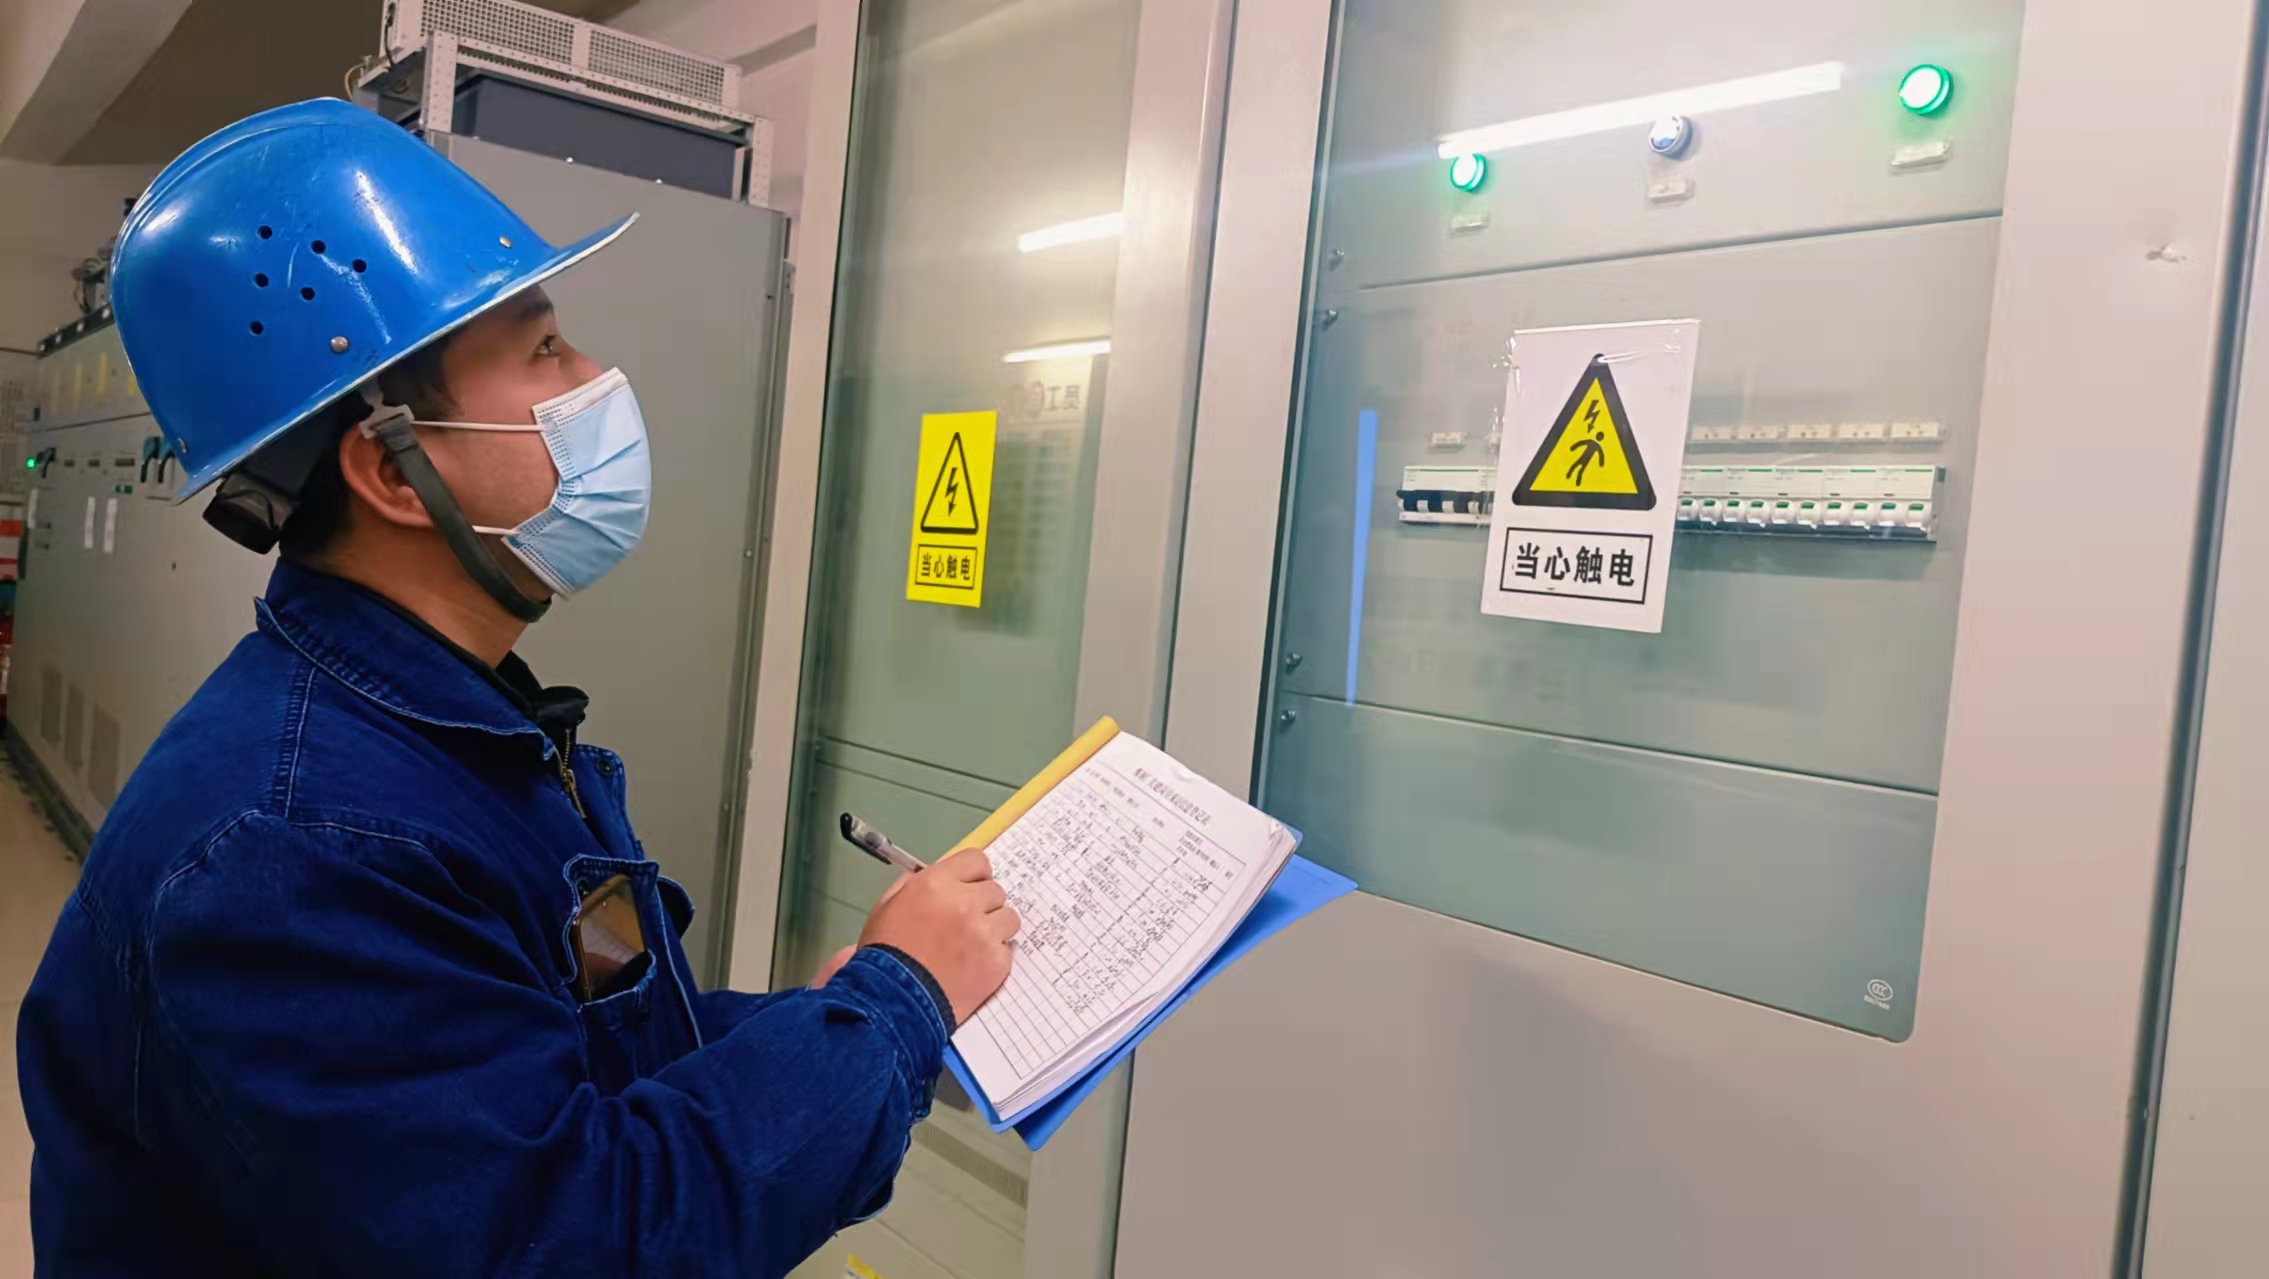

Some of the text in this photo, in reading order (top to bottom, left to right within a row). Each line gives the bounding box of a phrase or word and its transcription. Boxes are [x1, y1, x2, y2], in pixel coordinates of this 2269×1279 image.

[921, 552, 971, 580] 当心触电
[1514, 542, 1635, 587] 当心触电
